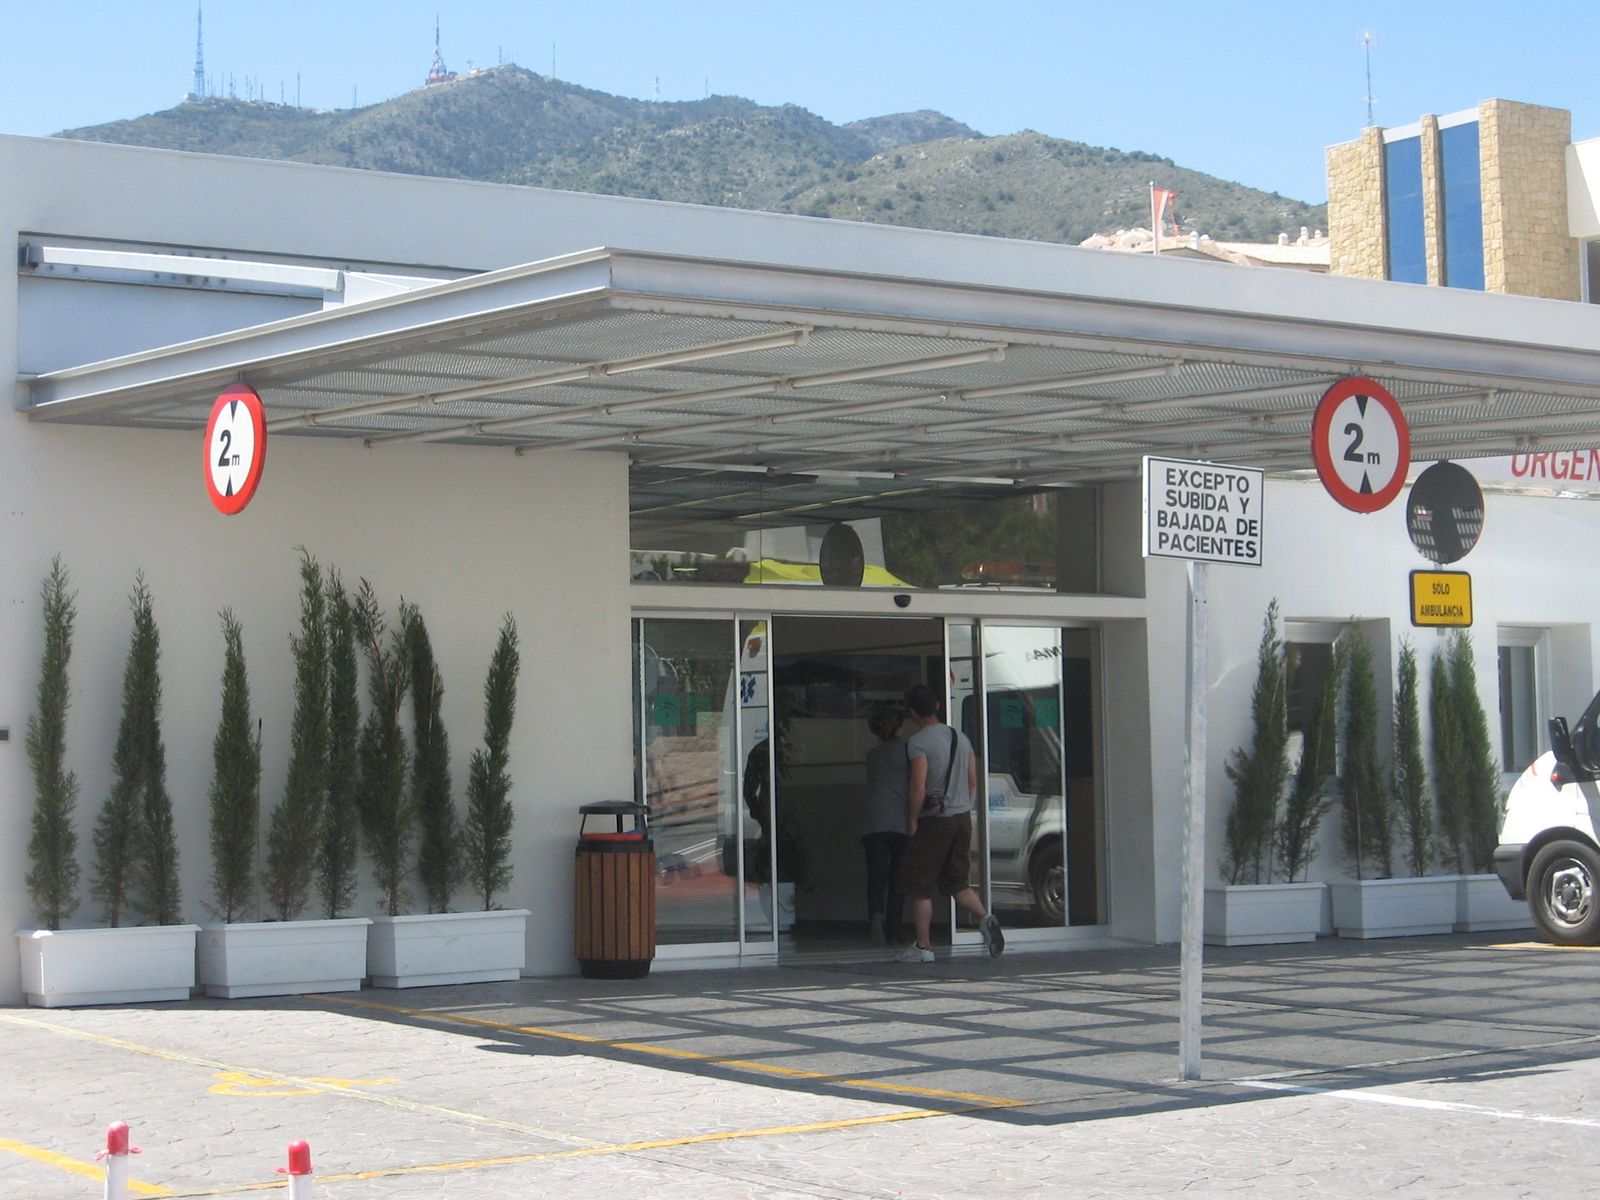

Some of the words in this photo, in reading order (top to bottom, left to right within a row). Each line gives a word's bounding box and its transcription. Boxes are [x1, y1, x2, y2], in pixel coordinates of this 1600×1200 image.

[1166, 468, 1250, 493] EXCEPTO
[1166, 489, 1229, 513] SUBIDA
[1239, 497, 1250, 515] Y
[1157, 509, 1227, 534] BAJADA
[1236, 518, 1258, 537] DE
[1158, 532, 1257, 558] PACIENTES
[1420, 605, 1464, 617] AMBULANCIA
